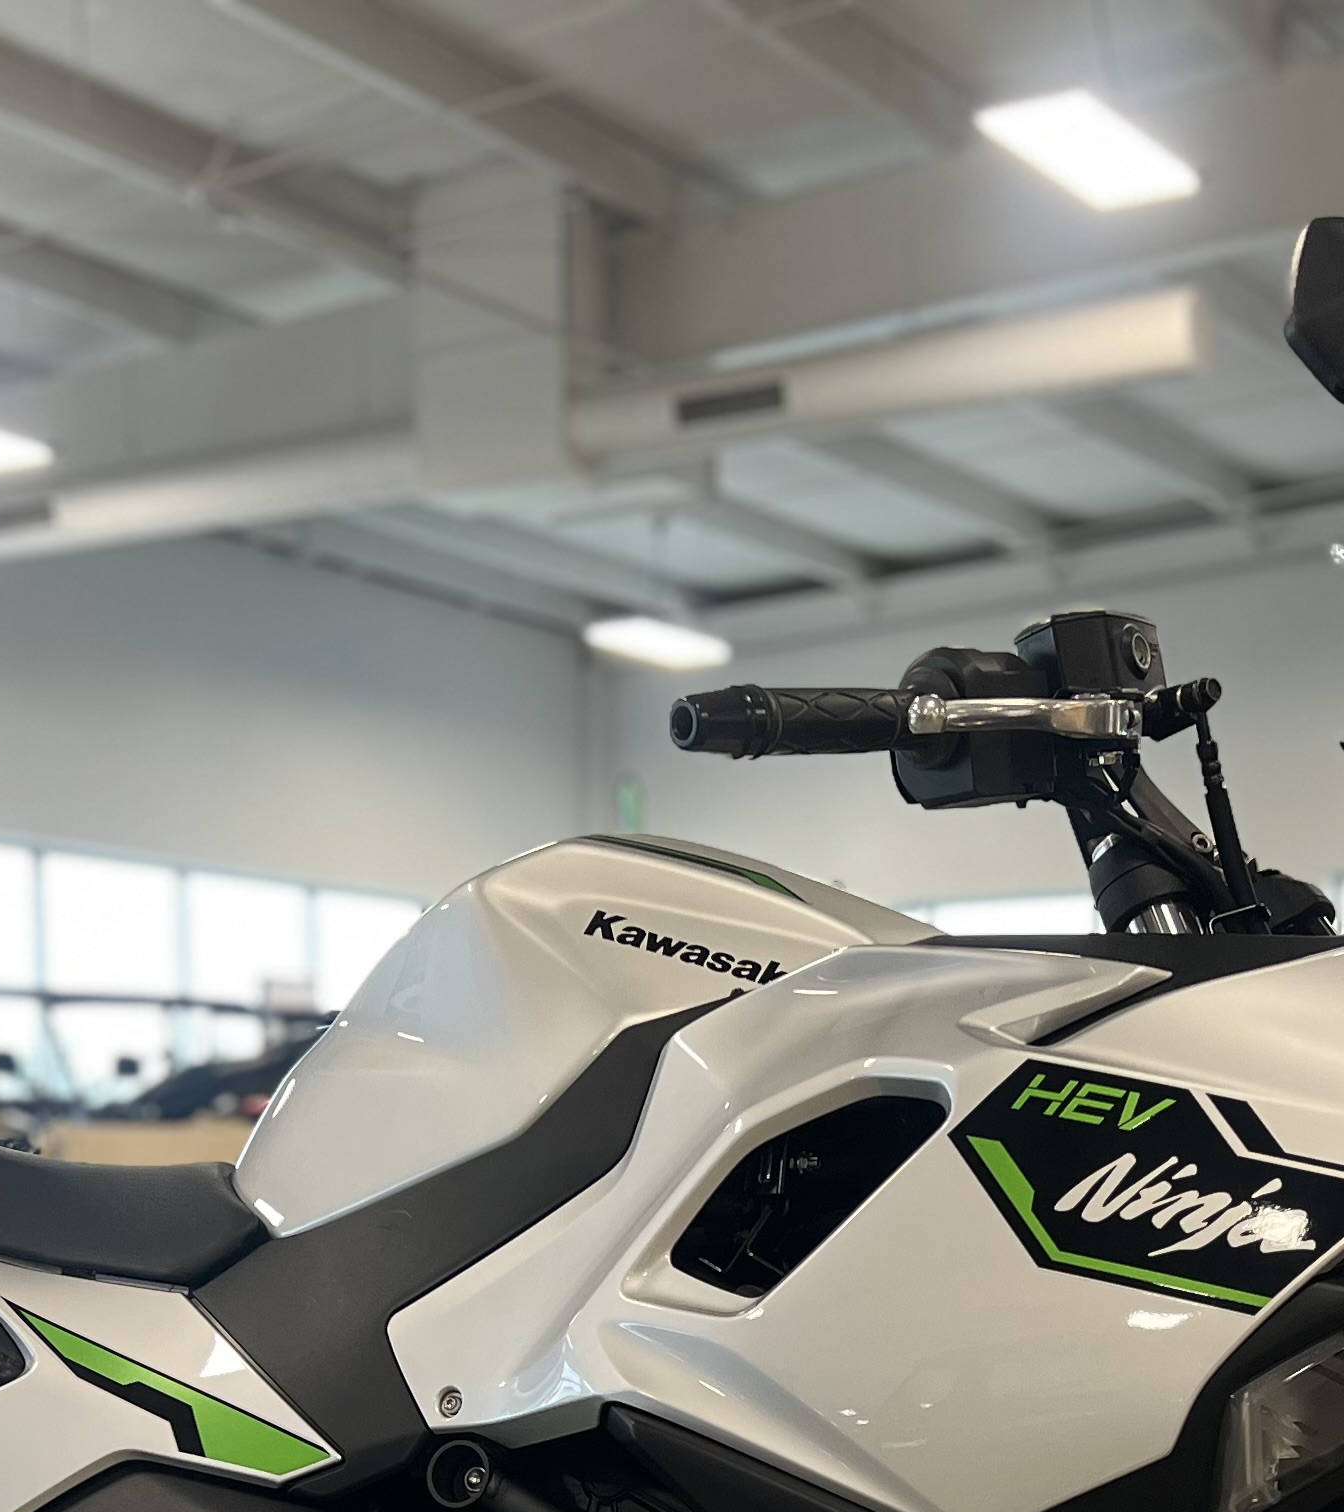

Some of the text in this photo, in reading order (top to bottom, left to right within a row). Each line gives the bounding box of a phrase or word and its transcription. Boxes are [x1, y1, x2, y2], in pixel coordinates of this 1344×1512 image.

[583, 909, 789, 986] Kawasak
[1011, 1073, 1177, 1131] HEV
[1053, 1152, 1317, 1257] Ninja
